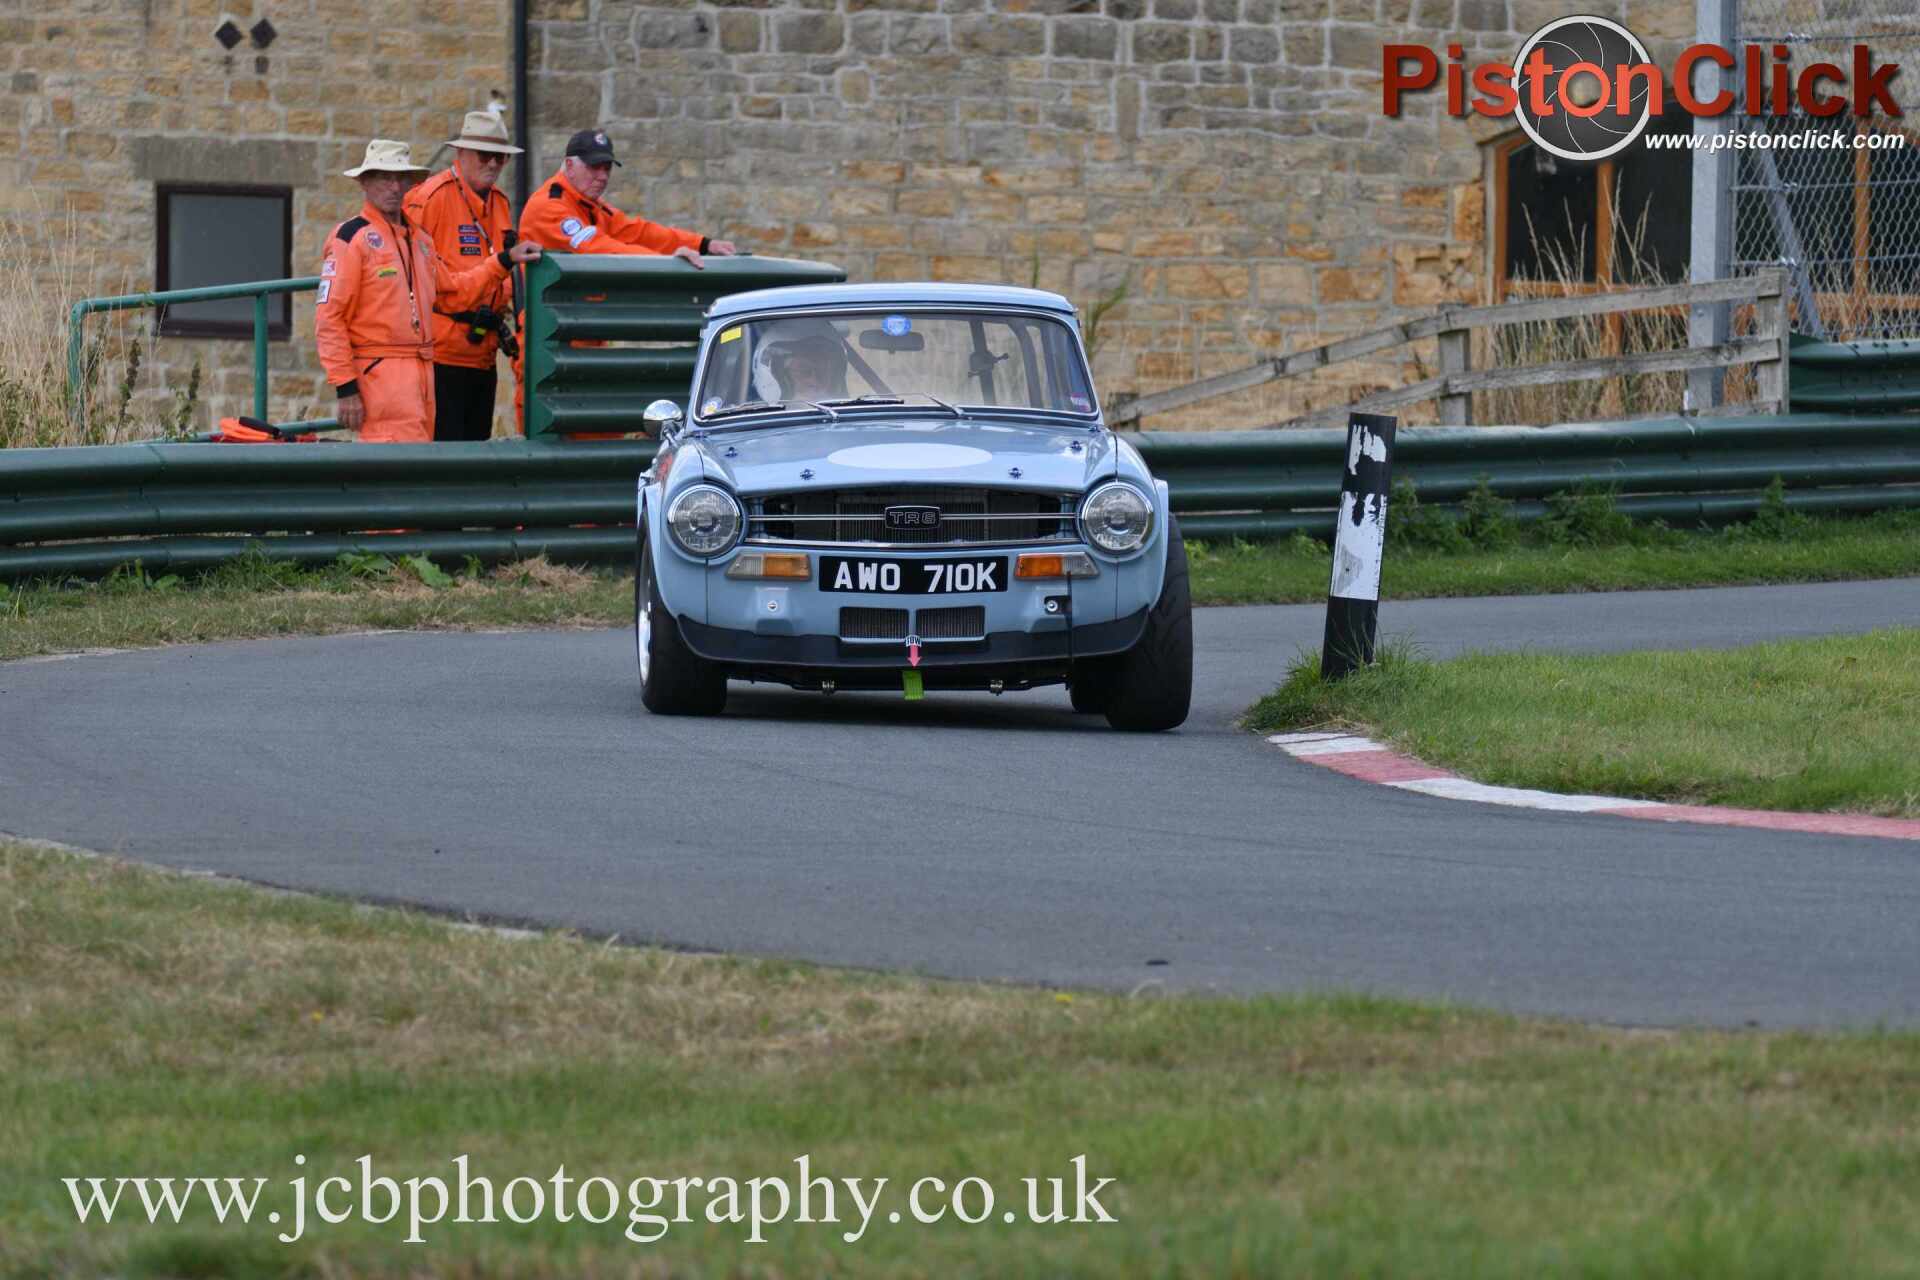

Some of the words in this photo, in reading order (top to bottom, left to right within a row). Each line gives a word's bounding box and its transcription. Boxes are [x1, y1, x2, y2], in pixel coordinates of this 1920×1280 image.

[889, 511, 936, 525] TR6
[833, 561, 901, 591] AWO
[923, 561, 997, 593] 710K
